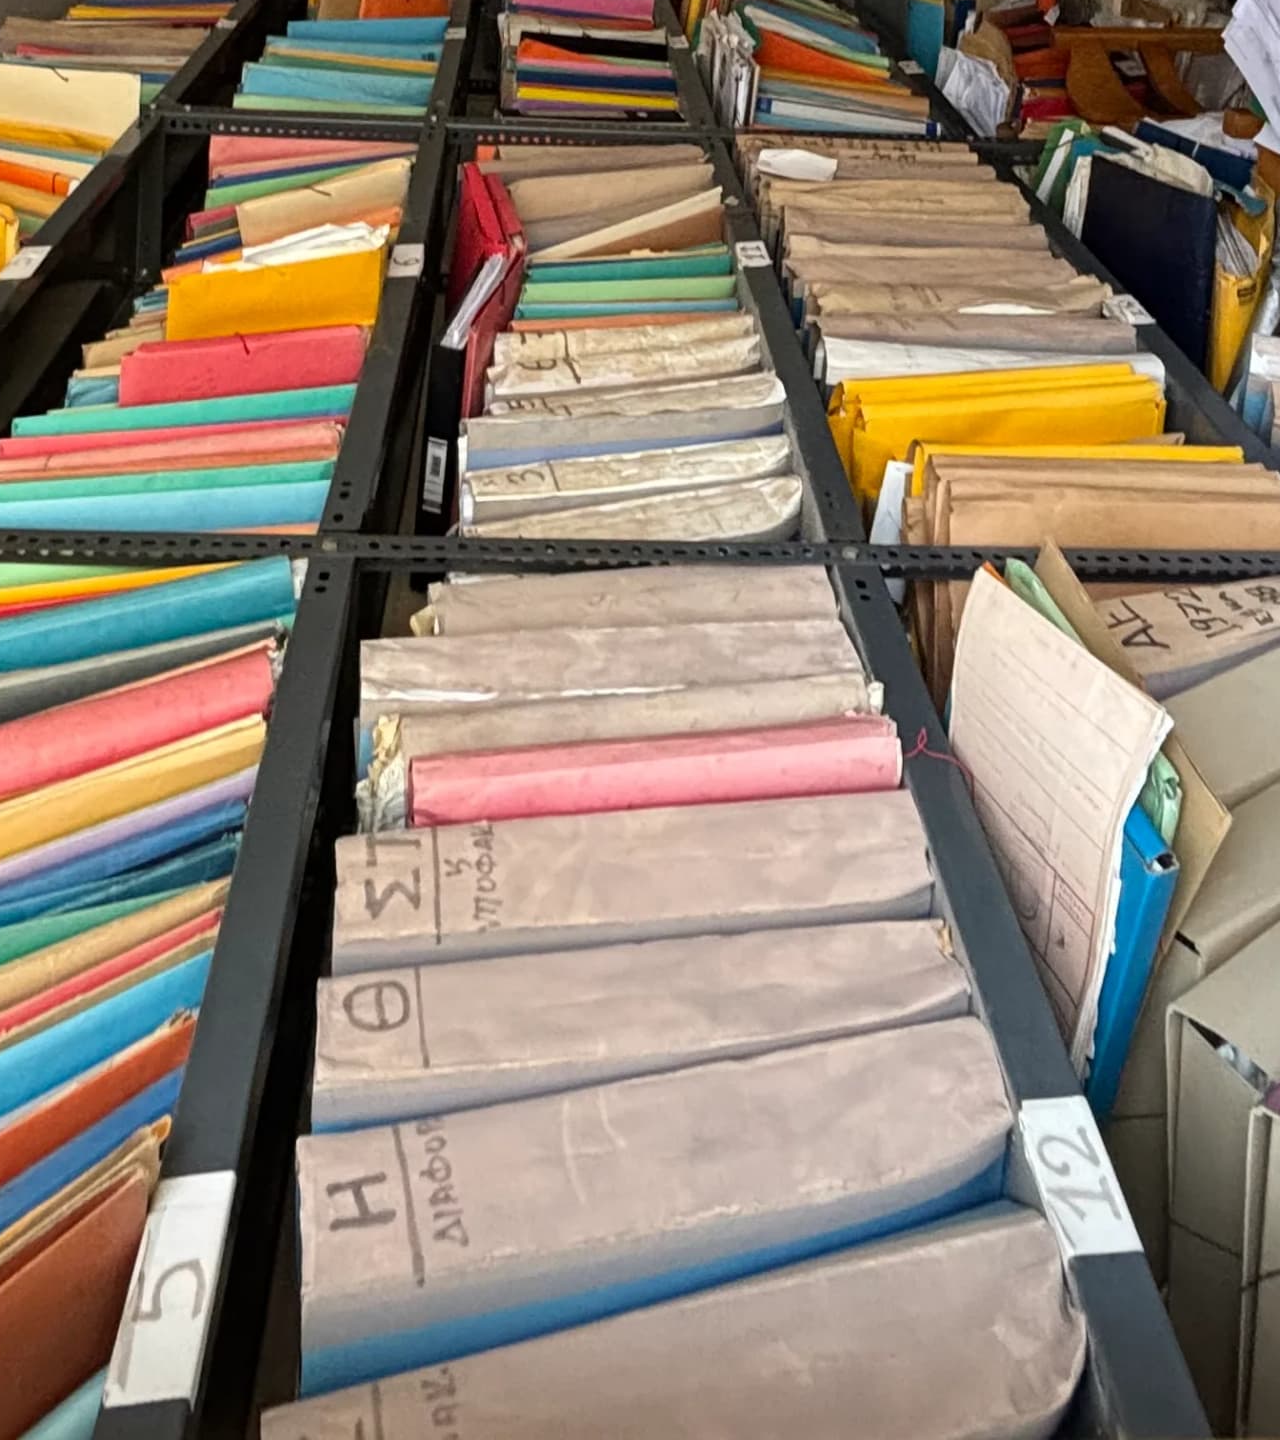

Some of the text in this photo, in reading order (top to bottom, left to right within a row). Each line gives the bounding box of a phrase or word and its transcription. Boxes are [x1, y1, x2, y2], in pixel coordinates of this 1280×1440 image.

[342, 981, 411, 1032] Θ
[325, 1171, 398, 1232] Η
[1037, 1125, 1122, 1221] 12
[130, 1258, 206, 1325] 5
